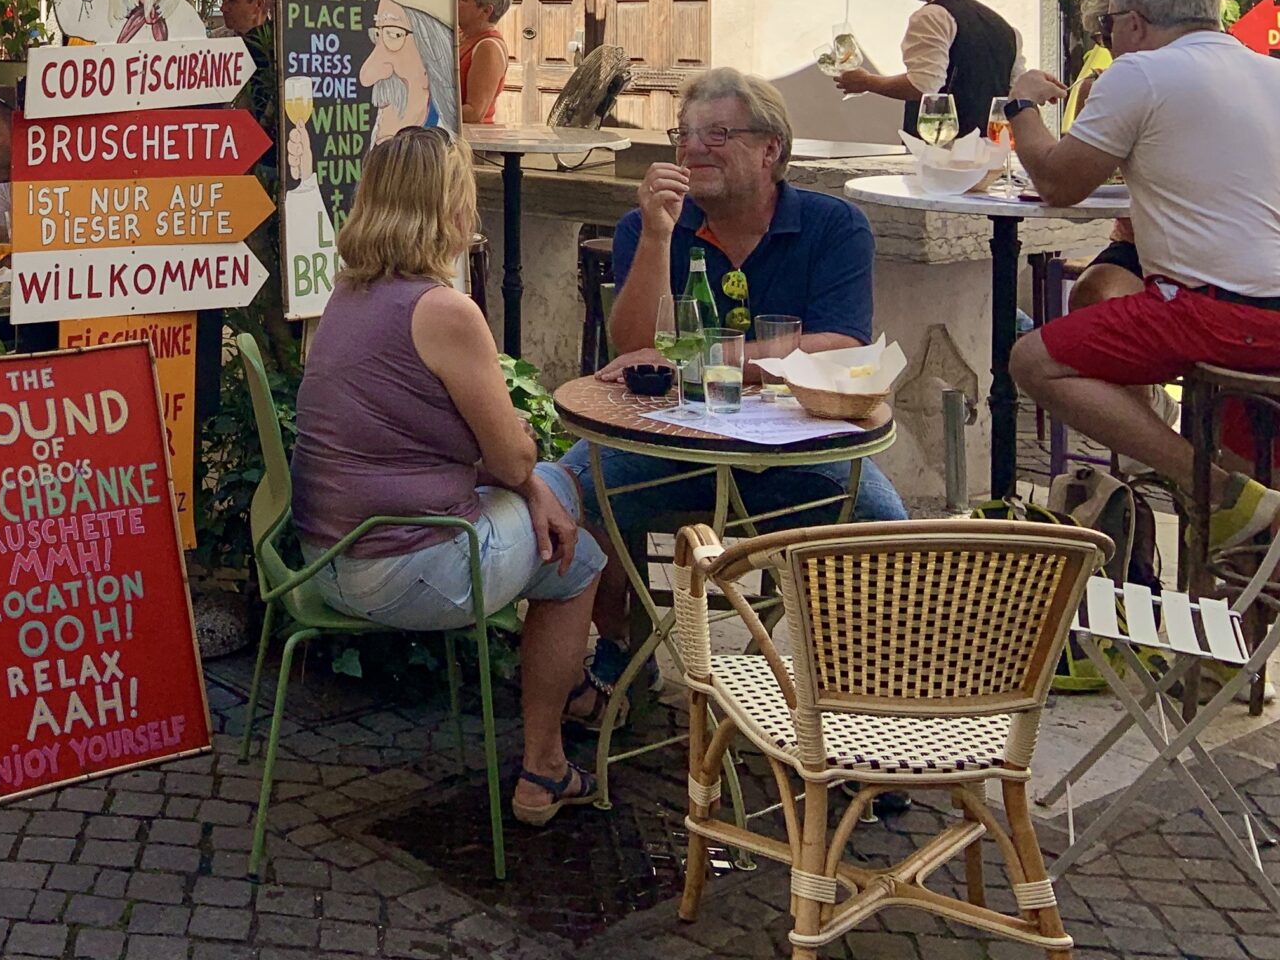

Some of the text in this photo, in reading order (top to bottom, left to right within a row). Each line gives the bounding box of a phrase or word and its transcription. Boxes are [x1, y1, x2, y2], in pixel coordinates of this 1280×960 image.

[287, 3, 363, 31] PLACE
[310, 33, 340, 53] NO
[40, 57, 116, 99] COBO
[287, 51, 352, 74] STRESS
[311, 77, 358, 98] ZONE
[27, 122, 240, 167] BRUSCHETTA
[323, 134, 364, 157] AND
[317, 159, 362, 186] FUN
[90, 185, 150, 215] NUR
[170, 182, 224, 210] AUF
[5, 367, 55, 391] THE
[31, 436, 65, 461] OF
[0, 458, 93, 490] COBO'S
[8, 537, 113, 586] MMH!
[18, 602, 134, 658] OOH!
[6, 650, 125, 699] RELAX
[26, 676, 139, 742] AAH!
[69, 715, 186, 768] YOURSELF
